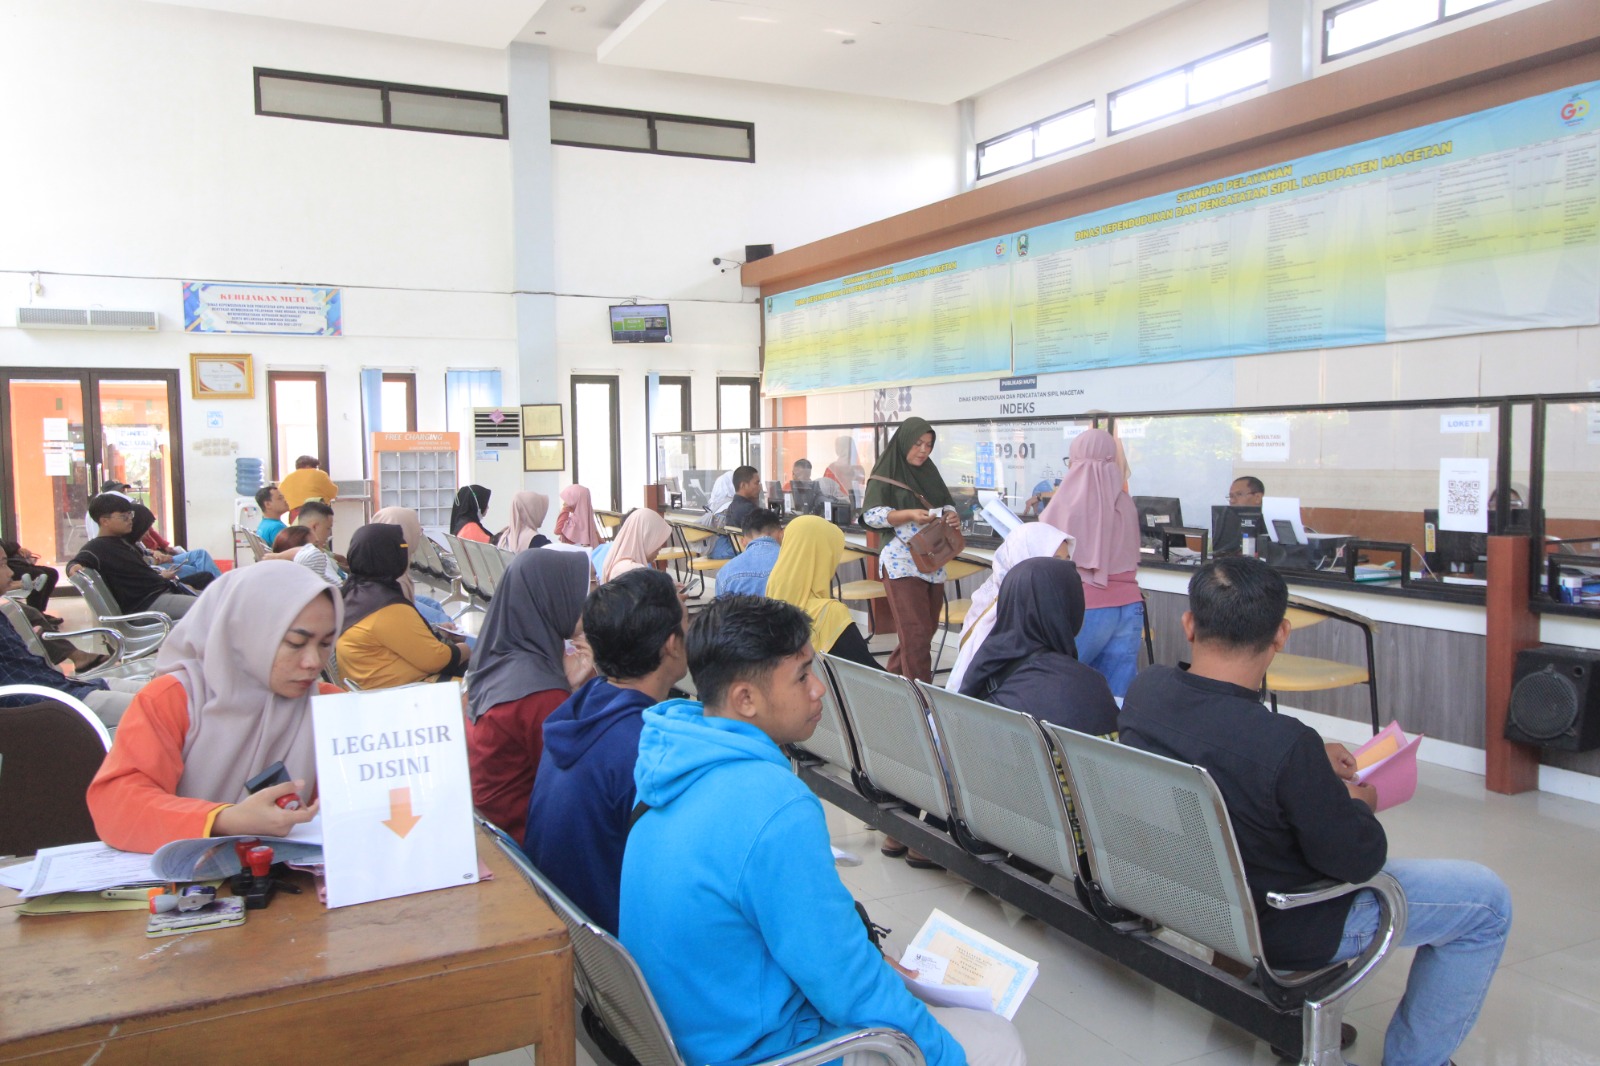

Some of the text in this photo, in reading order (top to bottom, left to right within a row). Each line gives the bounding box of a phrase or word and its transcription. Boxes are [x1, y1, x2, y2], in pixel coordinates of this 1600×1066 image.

[1176, 164, 1293, 203] STANDAR PELAYANAN
[1074, 140, 1453, 241] DINAS KEPENDUDUKAN DAN PENCATATAN SIPIL KABUPATEN MAGETAN
[929, 260, 957, 276] MAGETAN
[220, 293, 277, 302] KEBIJAKAN
[1001, 379, 1022, 387] PUBLIKASI
[972, 394, 1005, 402] KEPENDUDUKAN
[1000, 402, 1035, 415] INDEKS
[1447, 420, 1475, 428] LOKET
[385, 433, 443, 441] FREE CHARGING
[331, 725, 452, 756] LEGALISIR
[358, 755, 431, 782] DISINI
